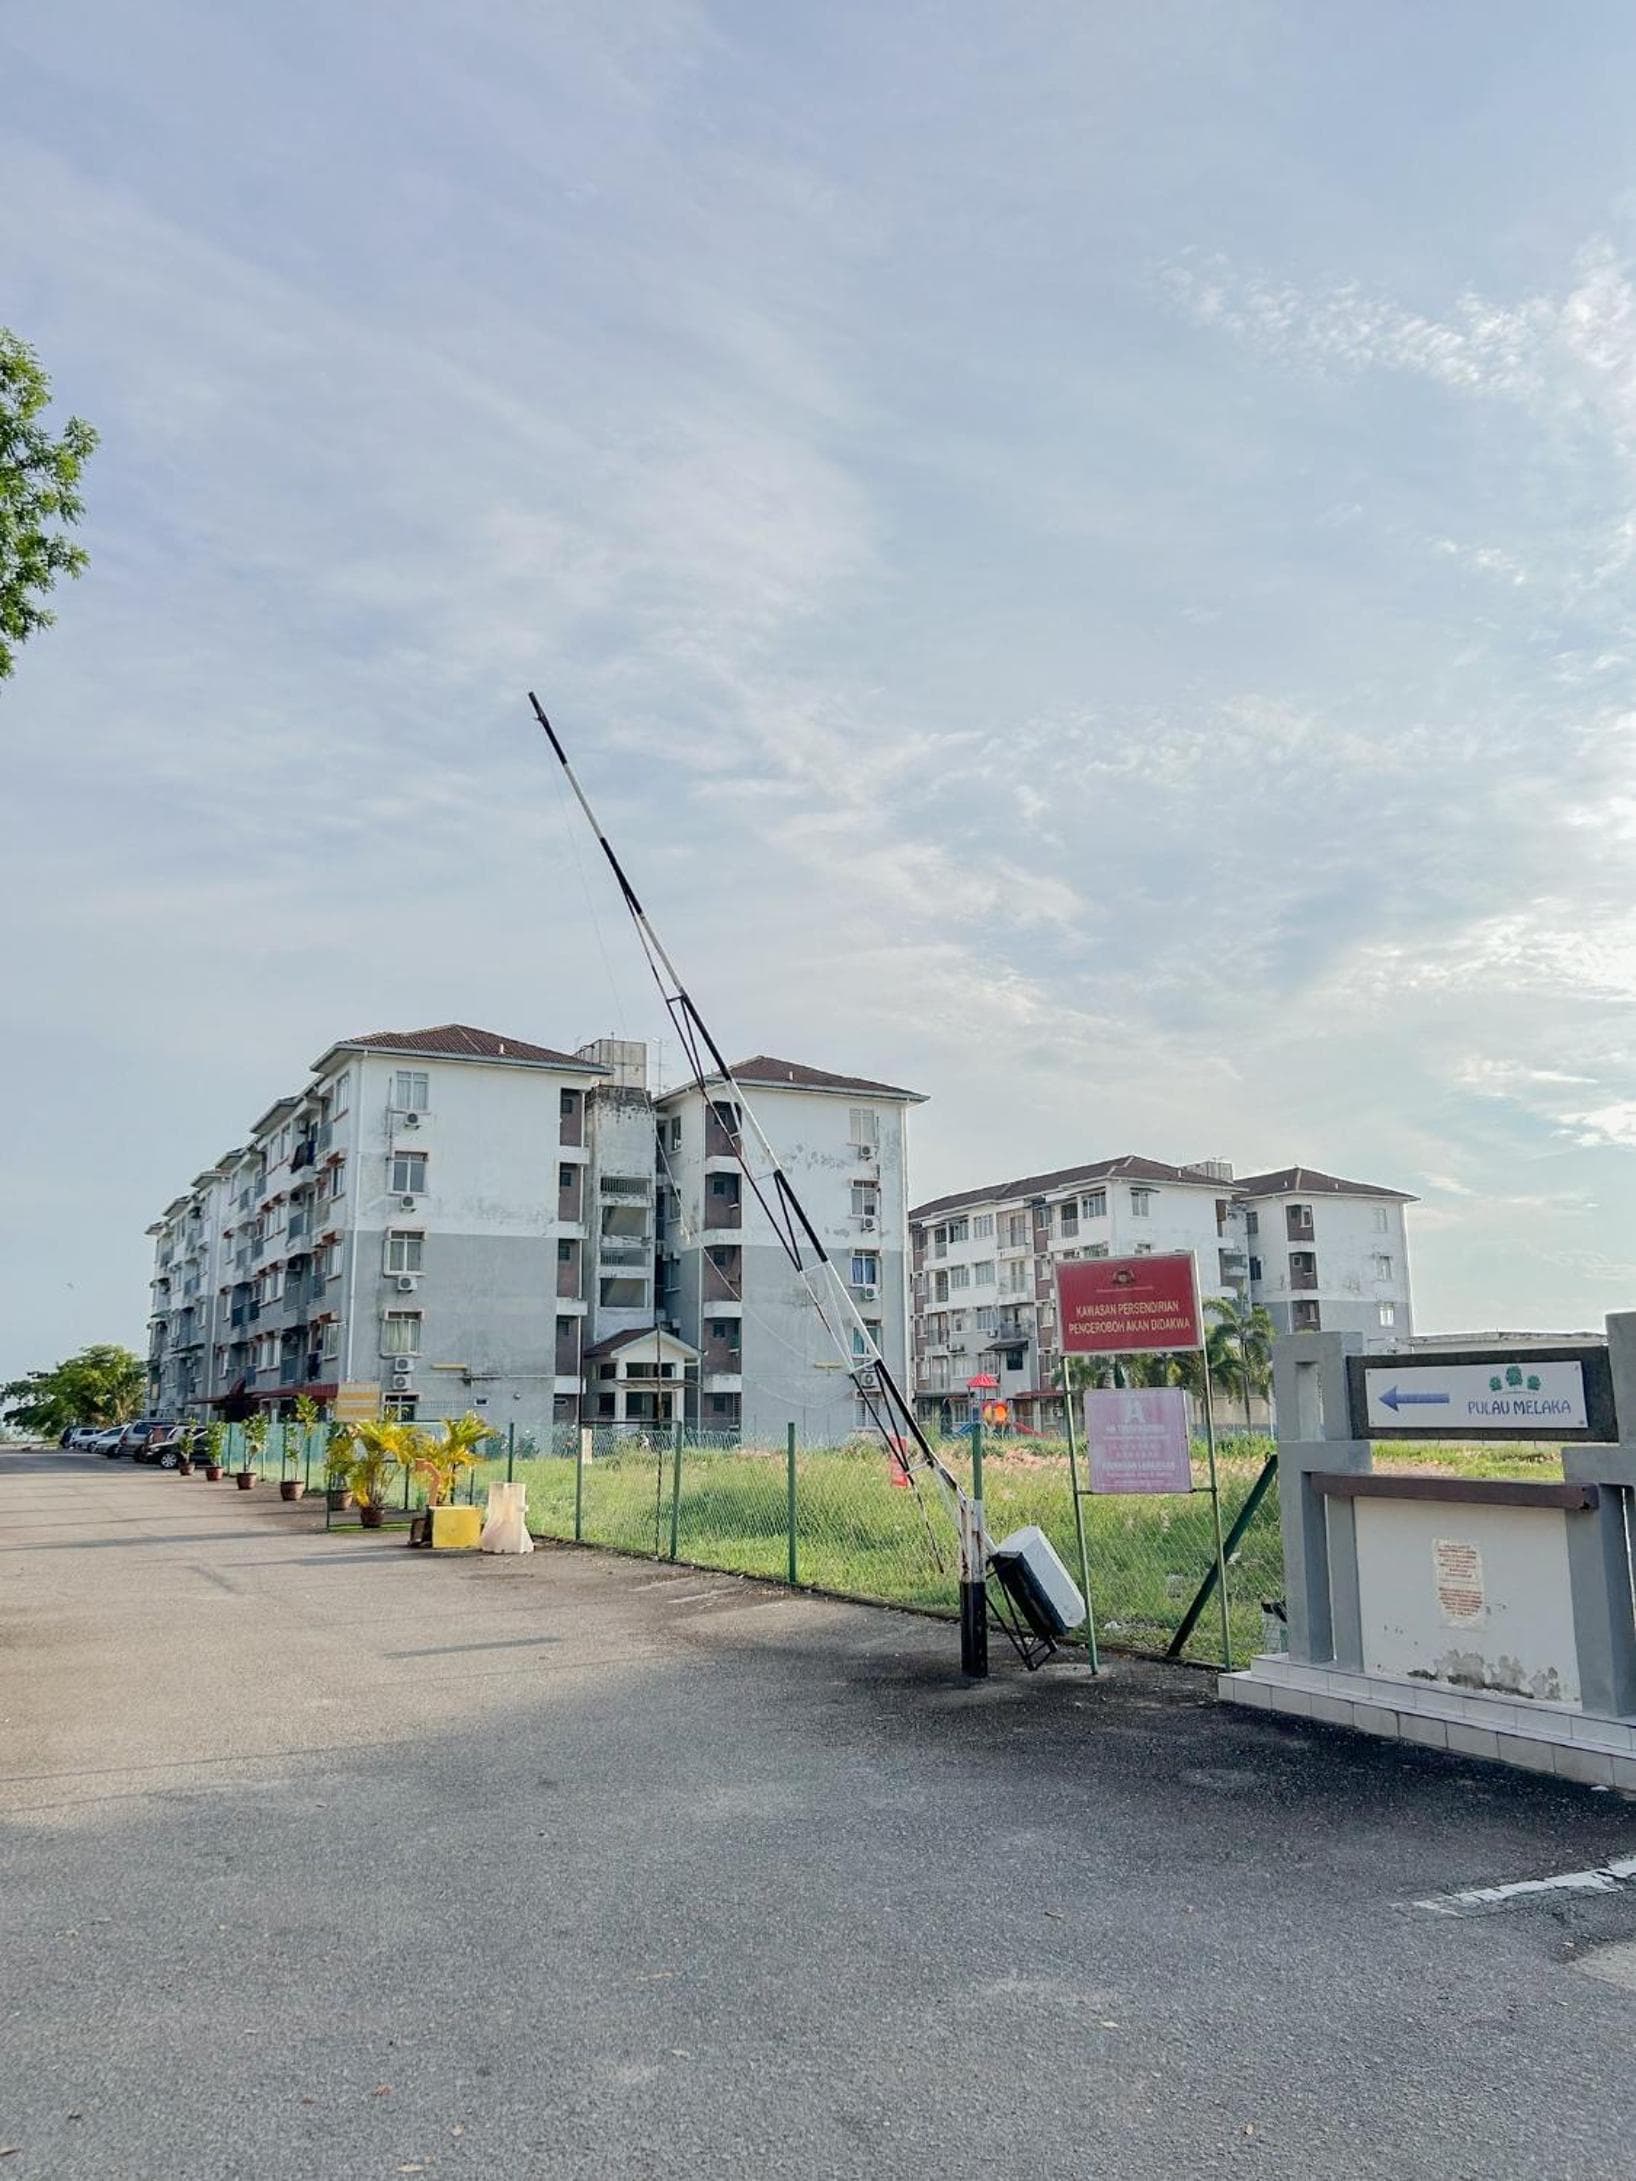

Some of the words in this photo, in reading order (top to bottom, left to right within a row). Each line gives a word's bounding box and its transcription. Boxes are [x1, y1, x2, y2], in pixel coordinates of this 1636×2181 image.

[1076, 1304, 1116, 1317] KAWASAN
[1118, 1300, 1179, 1315] PERSENDIRIAN
[1069, 1322, 1125, 1335] PENCEROBOH
[1126, 1320, 1150, 1332] AKAN
[1151, 1317, 1190, 1331] DIDAKWA
[1468, 1400, 1510, 1415] PULAU
[1513, 1399, 1571, 1415] MELAKA
